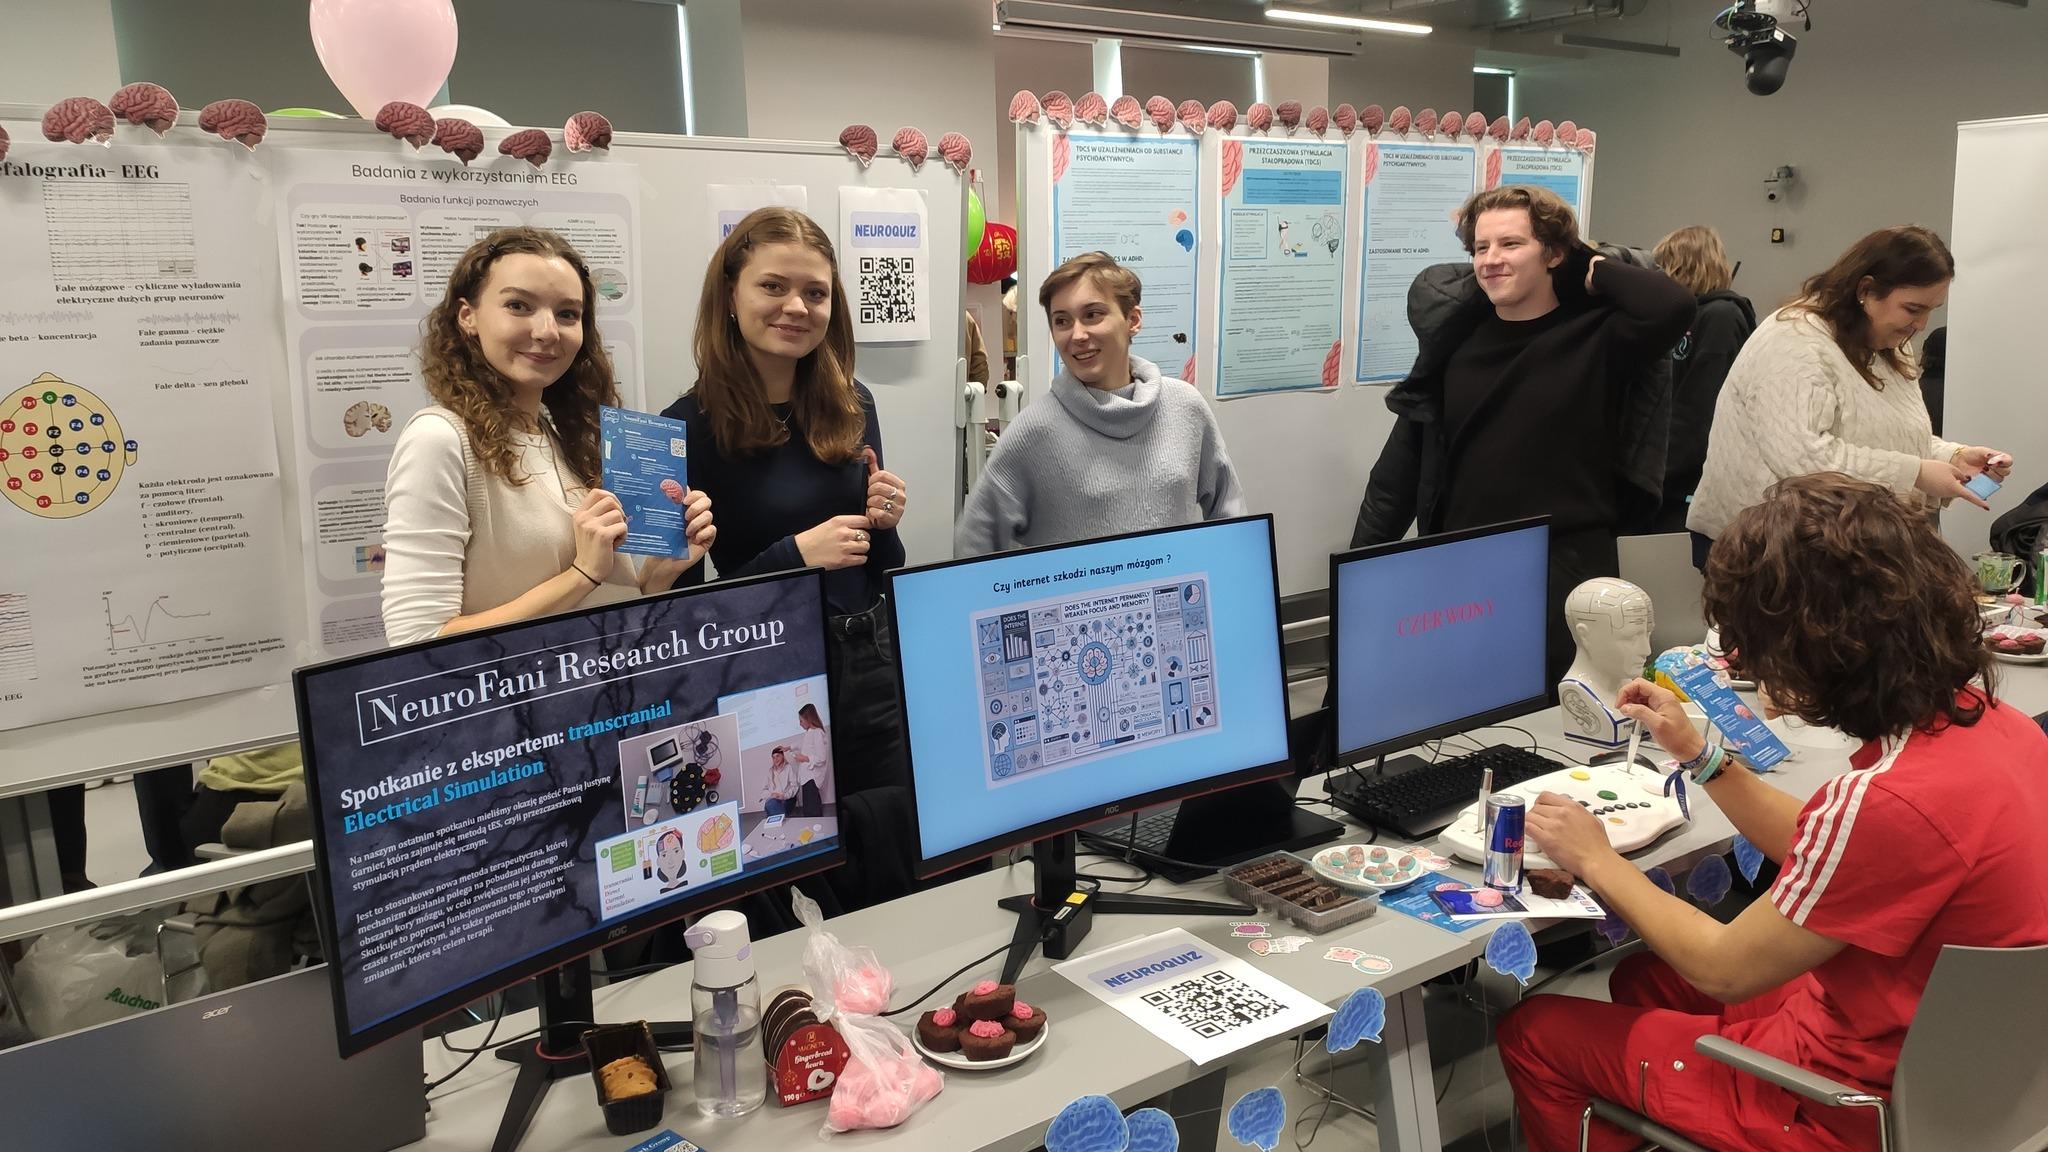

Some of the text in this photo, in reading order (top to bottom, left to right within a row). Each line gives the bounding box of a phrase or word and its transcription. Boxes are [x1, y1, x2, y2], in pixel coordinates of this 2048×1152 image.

[122, 165, 159, 179] EEG
[352, 164, 578, 185] Badania z wykorzystaniem EEG
[400, 194, 539, 208] Badania funkcji poznawczych
[855, 224, 917, 238] NEUROQUIZ
[55, 284, 77, 292] Fale
[79, 283, 125, 293] mózgowe
[135, 283, 178, 292] cykliczne
[56, 296, 115, 305] elektryczne
[117, 295, 151, 303] dużych
[38, 333, 97, 341] koncentracja
[175, 338, 220, 346] poznawcze
[138, 472, 273, 488] Każda elektroda jest oznakowana
[151, 490, 183, 499] pomocą
[993, 554, 1172, 593] Czy internet szkodzi naszym mózgom ?
[1064, 604, 1080, 612] DOES
[1064, 610, 1088, 618] WEAKEN
[1089, 605, 1108, 614] FOCUS
[1121, 598, 1149, 609] MEMORY?
[1397, 598, 1495, 637] CZERWONY
[368, 617, 785, 731] NeuroFani Research Group
[341, 700, 671, 811] Spotkanie z ekspertem: transcranial
[344, 759, 544, 834] Electrical Simulation
[350, 775, 610, 865] Na naszym ostatnim spotkaniu mieliśmy okazję gościć Panią Justynę
[351, 796, 582, 878] Garnier, która zajmuje się metodą tES, czyli przezczaszkową
[352, 838, 488, 891] stymulacją prądem elektrycznym.
[356, 838, 568, 924] Jest to stosunkowo nowa metoda terapeutyczna, której
[358, 855, 558, 934] mechanizm działania polega na pobudzaniu danego
[359, 859, 574, 947] obszaru kory mózgu, w celu zwiększenia jej aktywności.
[360, 875, 563, 959] Skutkuje to poprawą funkcjonowania tego regionu w
[362, 884, 565, 971] czasie rzeczywistym, ale także potencjalnie trwałymi
[363, 924, 494, 984] zmianami, które są celem terapii.
[1104, 950, 1203, 988] NEUROQUIZ
[105, 987, 160, 1010] Auchan
[202, 1005, 232, 1020] acer
[794, 1047, 833, 1064] Gingerbread
[805, 1060, 825, 1069] hearts
[784, 1093, 795, 1102] 190
